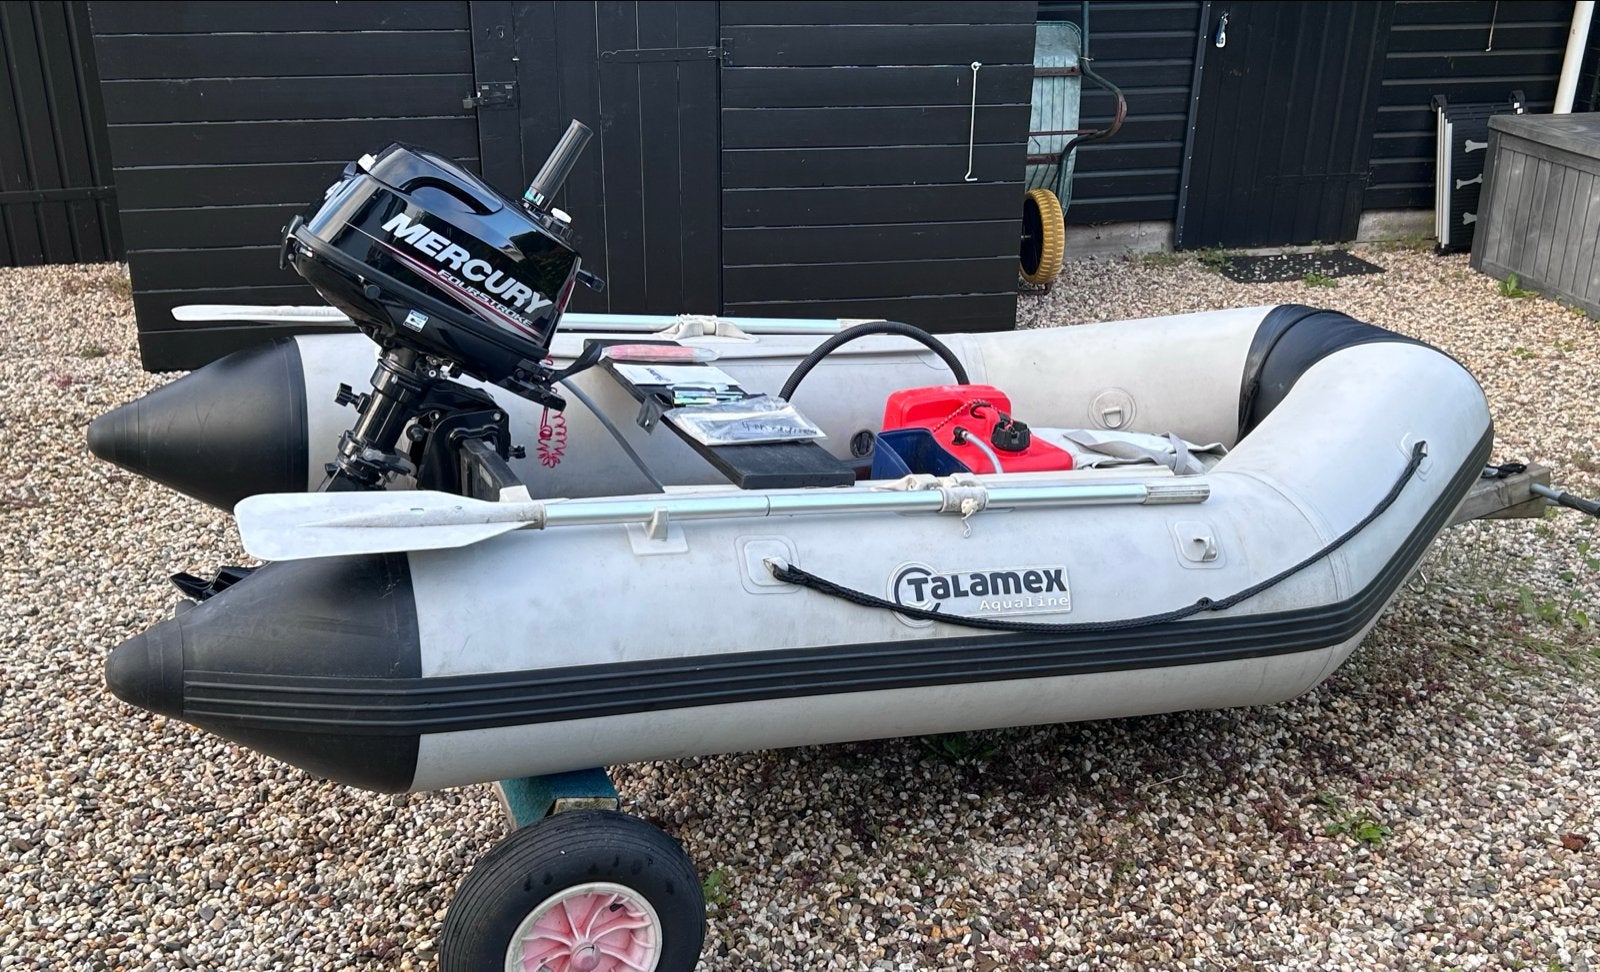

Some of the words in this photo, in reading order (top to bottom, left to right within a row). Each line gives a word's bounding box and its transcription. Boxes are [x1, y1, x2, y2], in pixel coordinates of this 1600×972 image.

[382, 212, 552, 314] MERCURY
[436, 269, 533, 327] FOURSTROKE
[979, 596, 1069, 612] Aqualine
